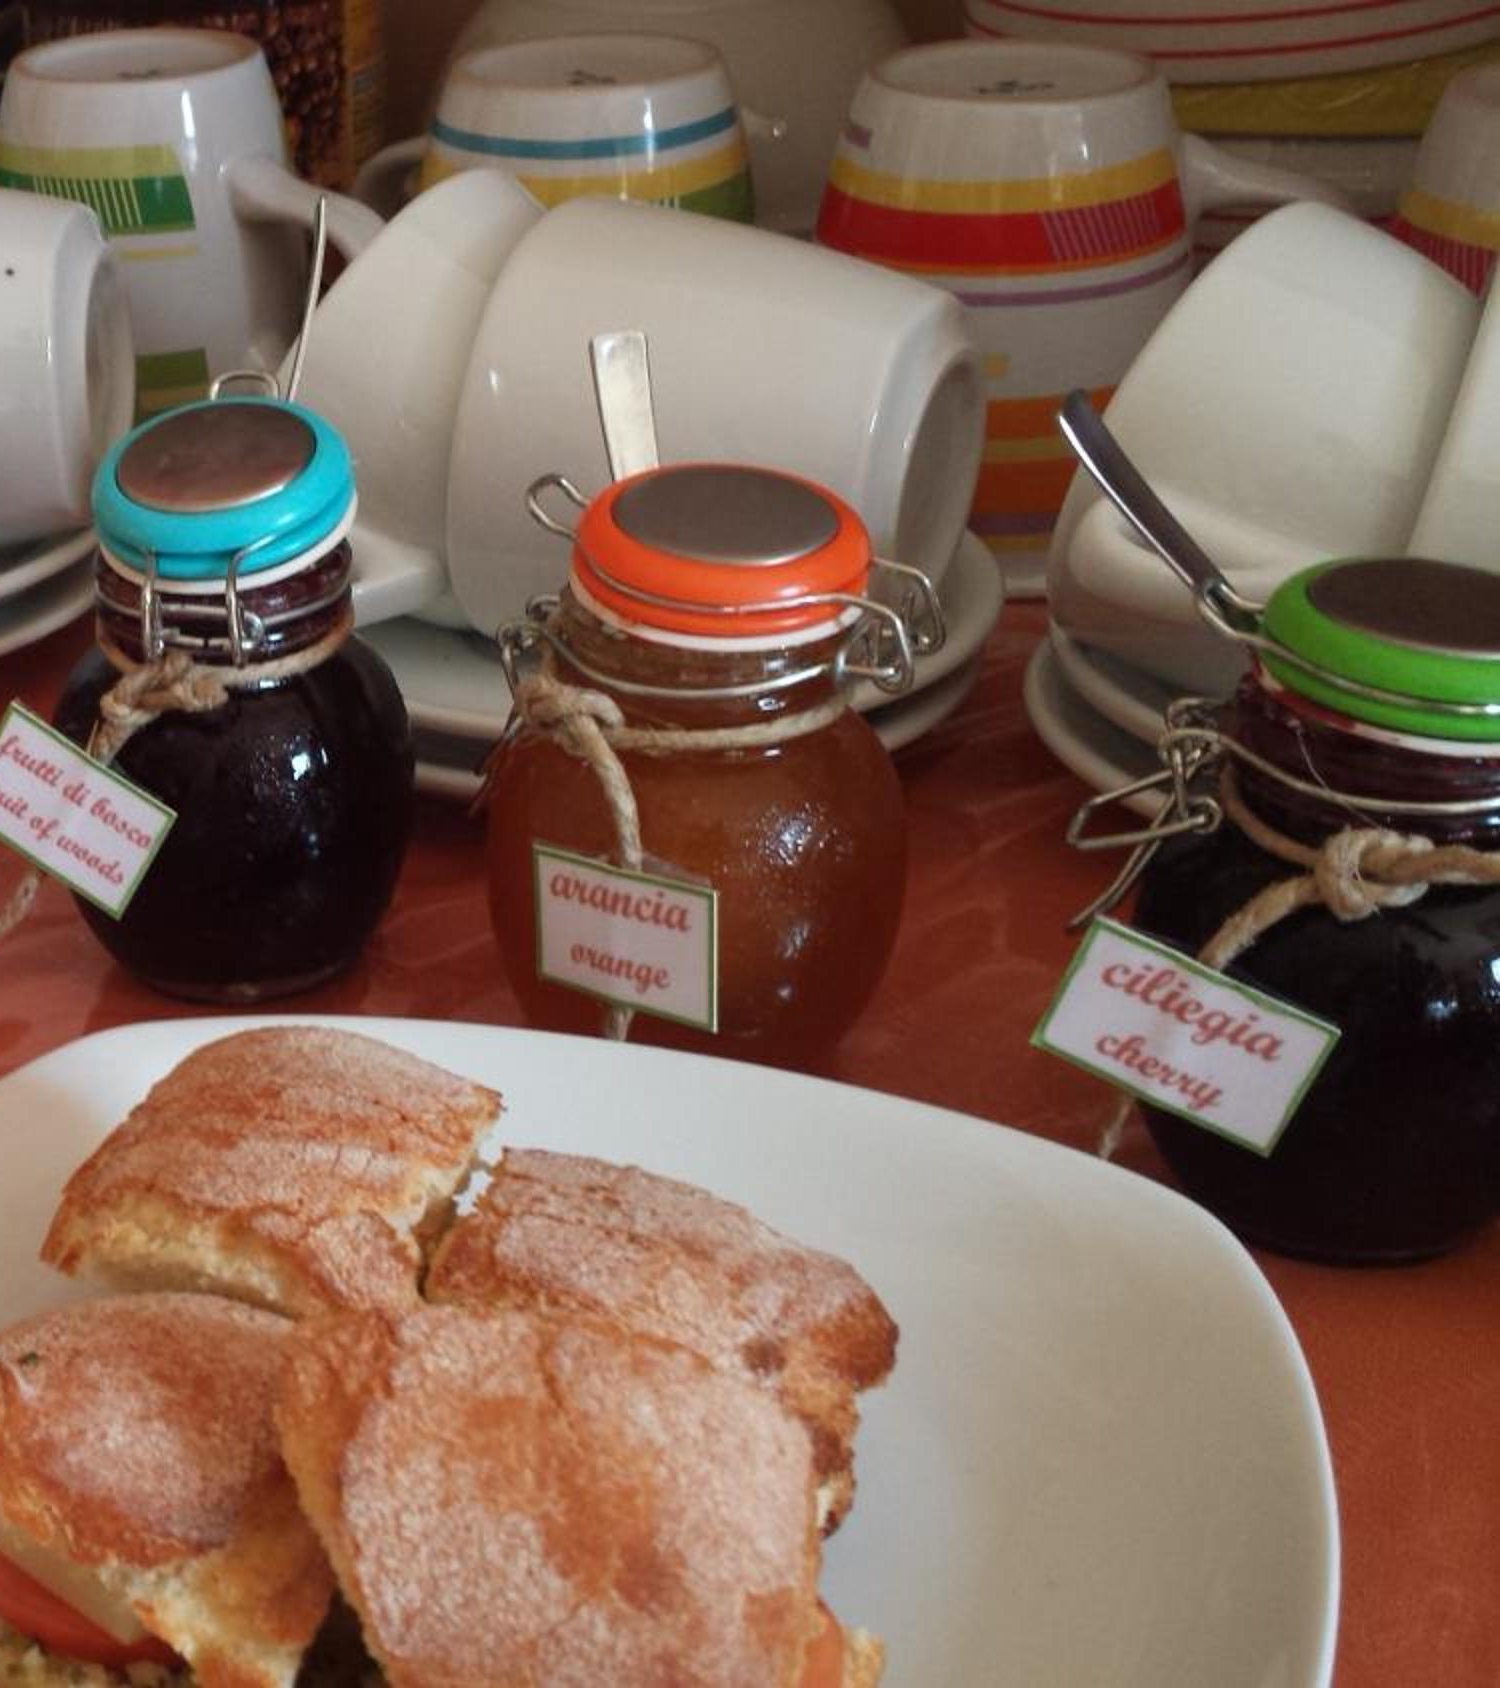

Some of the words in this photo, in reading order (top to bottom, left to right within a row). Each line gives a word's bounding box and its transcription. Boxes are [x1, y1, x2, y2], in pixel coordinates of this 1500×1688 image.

[28, 815, 59, 841] of
[56, 834, 124, 886] woods
[62, 781, 91, 806] di
[90, 797, 152, 850] bosco
[550, 872, 691, 932] arancia
[570, 943, 670, 994] orange
[1101, 963, 1284, 1062] ciliegia
[1096, 1032, 1223, 1111] cherry
